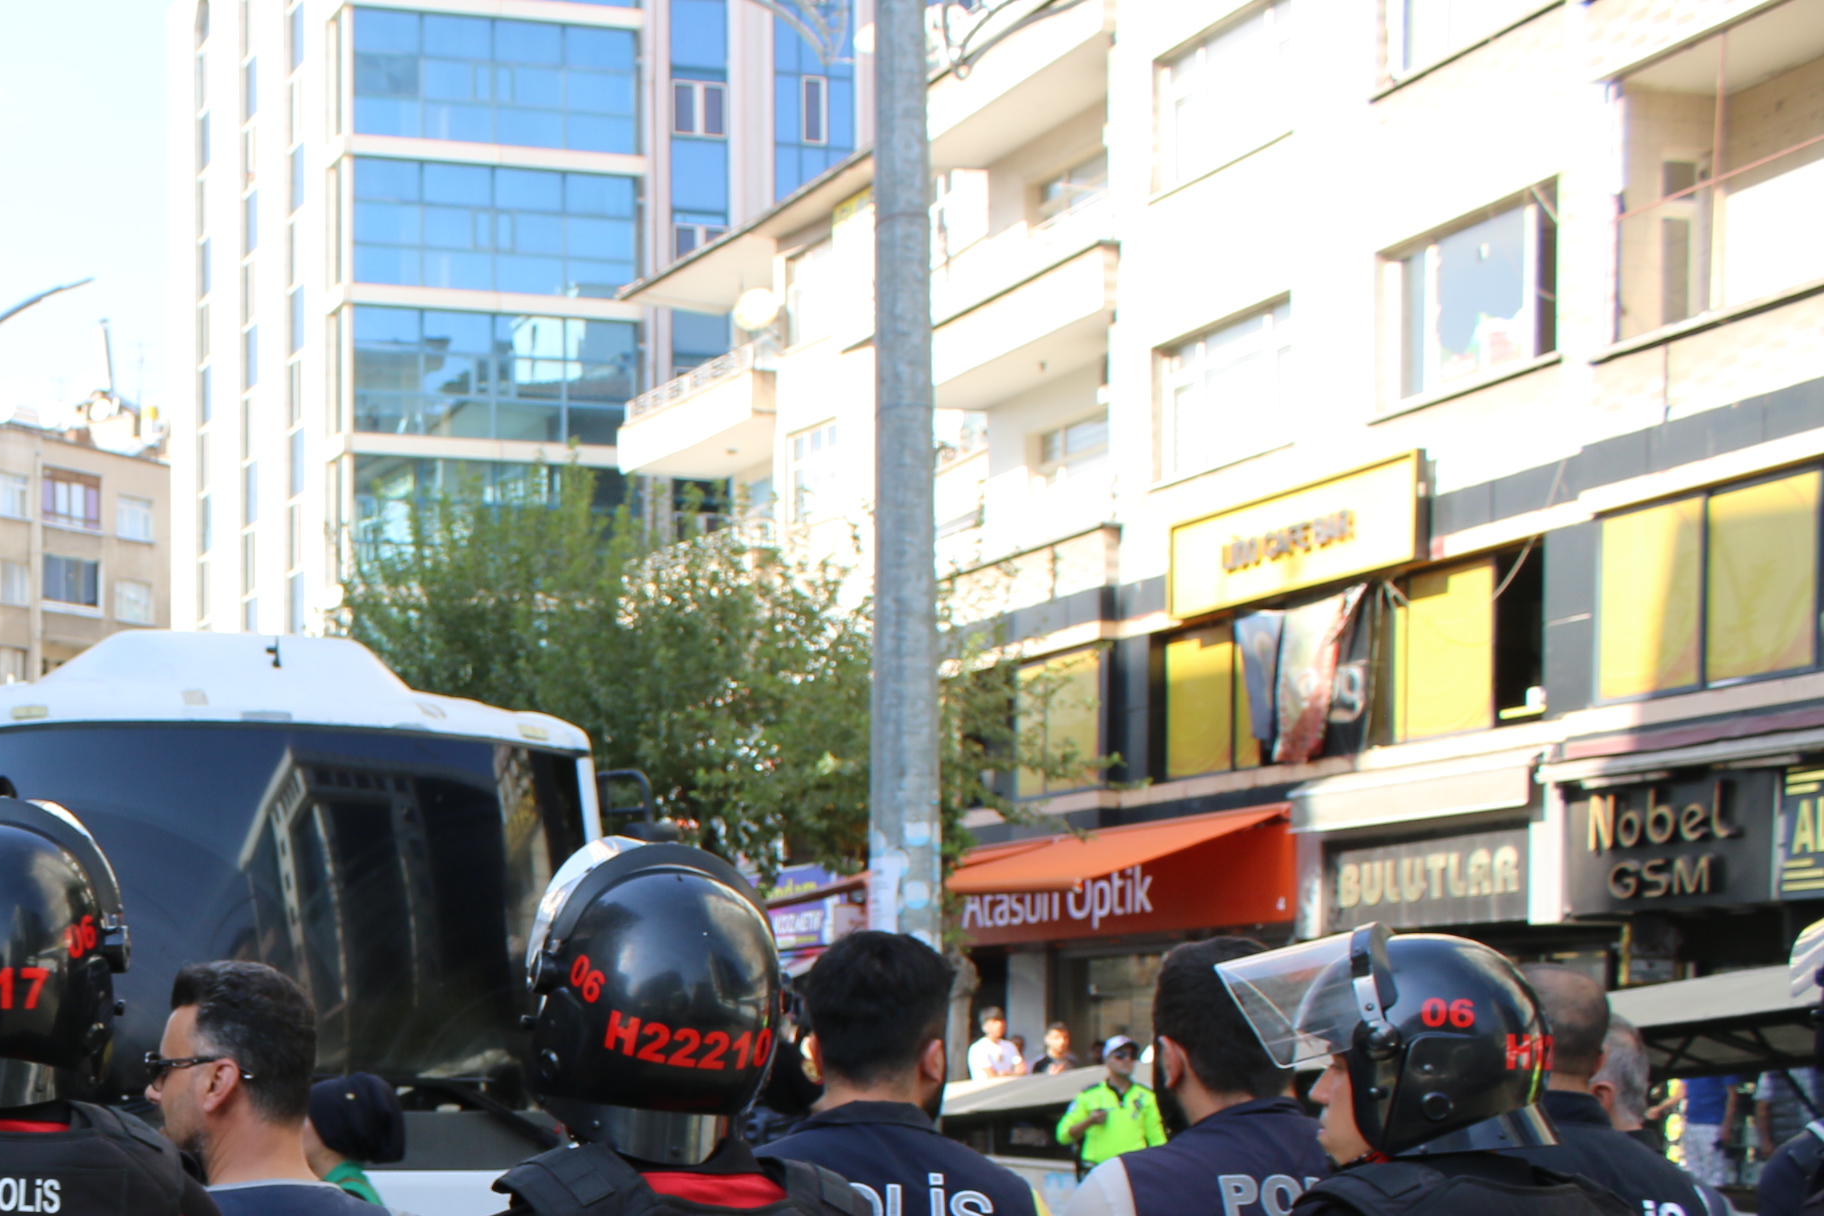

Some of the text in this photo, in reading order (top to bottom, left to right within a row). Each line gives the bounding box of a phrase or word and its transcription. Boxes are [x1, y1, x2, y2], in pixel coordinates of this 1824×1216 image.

[1587, 780, 1731, 851] Nobel
[1338, 846, 1519, 908] BULUTLAR
[1608, 855, 1711, 899] GSM
[65, 914, 96, 958] 06
[570, 954, 606, 1003] 06
[1421, 997, 1475, 1028] 06
[604, 1009, 772, 1070] H22210
